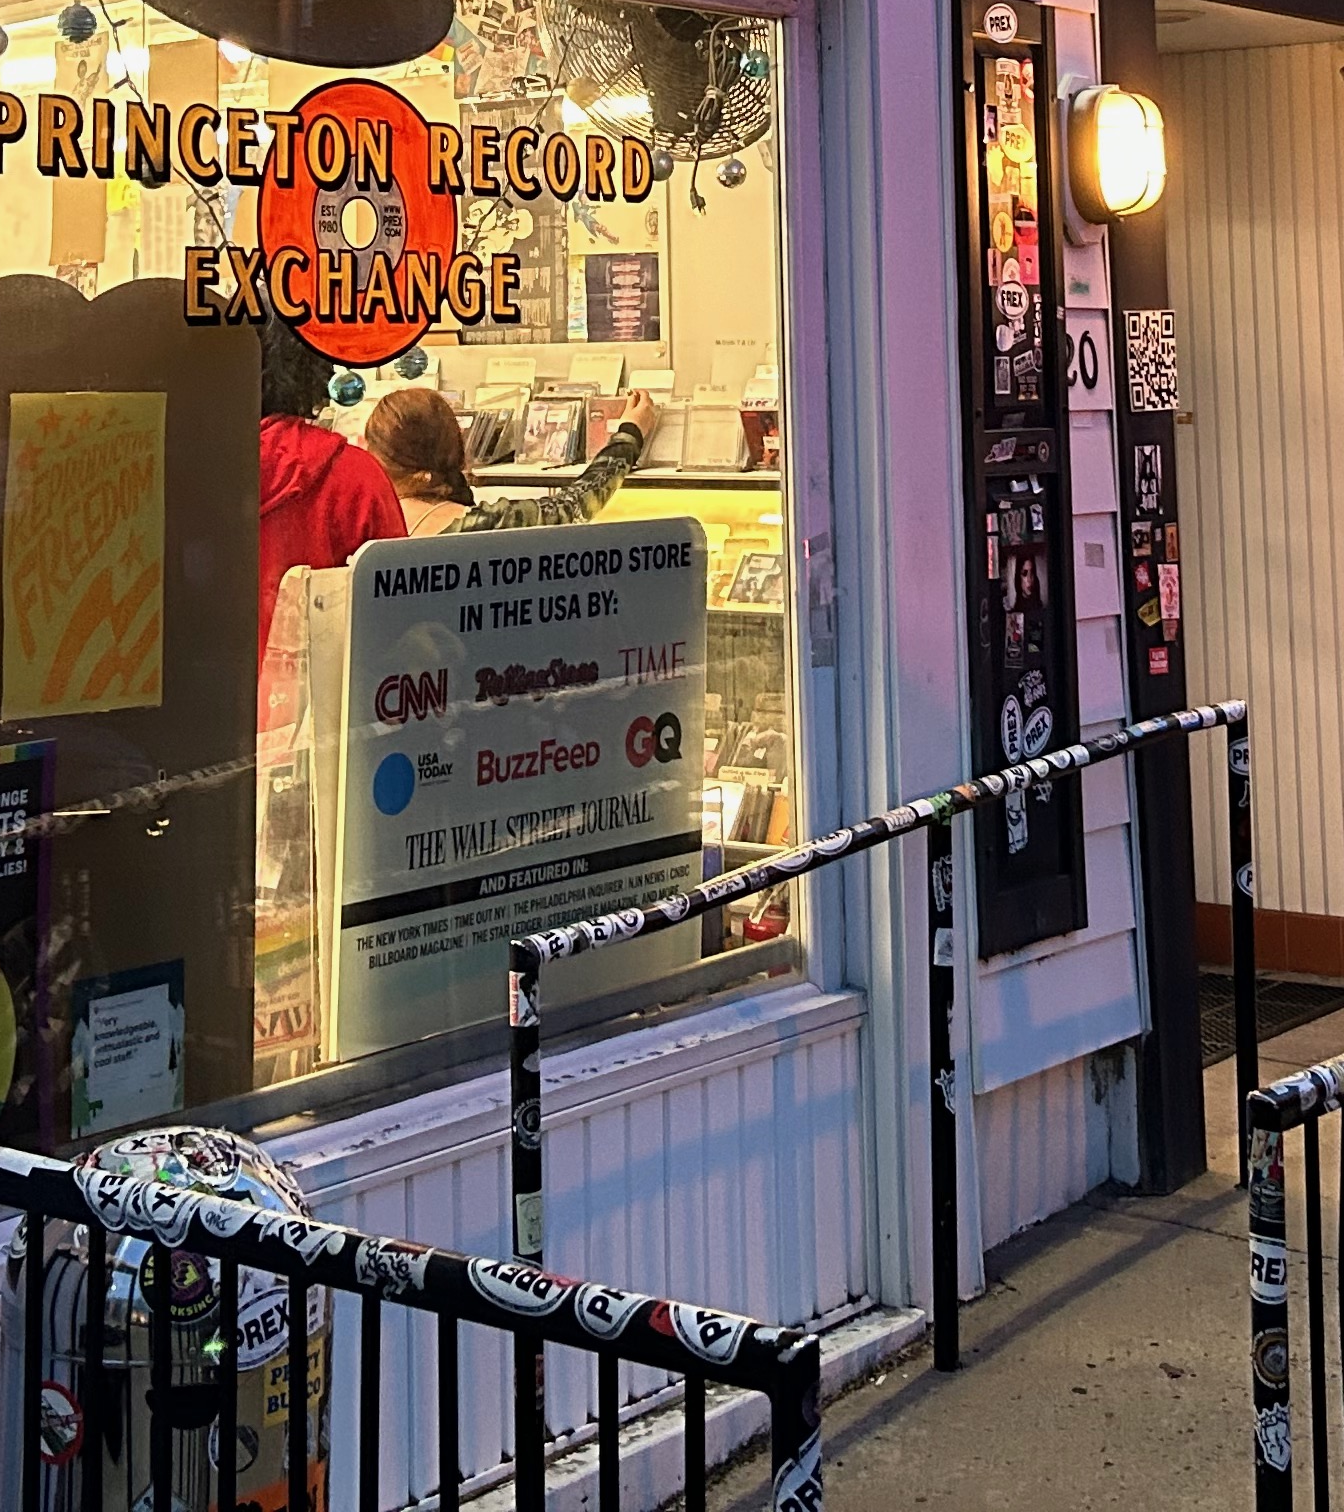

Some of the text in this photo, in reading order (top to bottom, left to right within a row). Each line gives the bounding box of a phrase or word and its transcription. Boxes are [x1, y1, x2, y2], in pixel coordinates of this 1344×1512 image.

[989, 13, 1013, 33] PREX
[430, 121, 655, 201] RECORD
[319, 220, 338, 233] 1980
[321, 205, 337, 216] EST.
[383, 216, 403, 227] PREX
[383, 228, 401, 237] COM
[184, 246, 522, 325] EXCHANGE
[374, 542, 691, 598] NAMED A TOP RECORD STORE
[459, 589, 618, 632] IN THE USA BY:
[375, 668, 448, 725] CNN
[618, 641, 686, 687] TIME
[625, 712, 682, 768] GQ
[1008, 707, 1018, 755] PREX
[1026, 717, 1049, 748] PREX
[418, 753, 439, 767] USA
[14, 838, 25, 856] &
[406, 828, 446, 870] THE
[452, 819, 497, 859] WALL
[506, 806, 576, 848] STREET
[479, 859, 589, 896] AND FEATURED IN:
[356, 934, 374, 952] THE
[376, 930, 395, 948] NEW
[398, 925, 422, 944] YORK
[422, 920, 449, 939] TIMES
[455, 914, 475, 931] TIME
[476, 911, 492, 927] OUT
[494, 908, 506, 924] NY
[513, 901, 529, 917] THE
[530, 888, 586, 915] PHILADELPHIA
[587, 881, 624, 903] INQUIRER
[643, 871, 665, 890] NEWS
[670, 864, 691, 883] CNBC
[369, 947, 418, 969] BILLBOARD
[419, 935, 463, 961] MAGAZINE
[472, 929, 489, 946] THE
[490, 924, 510, 942] STAR
[511, 917, 543, 937] LEDGER
